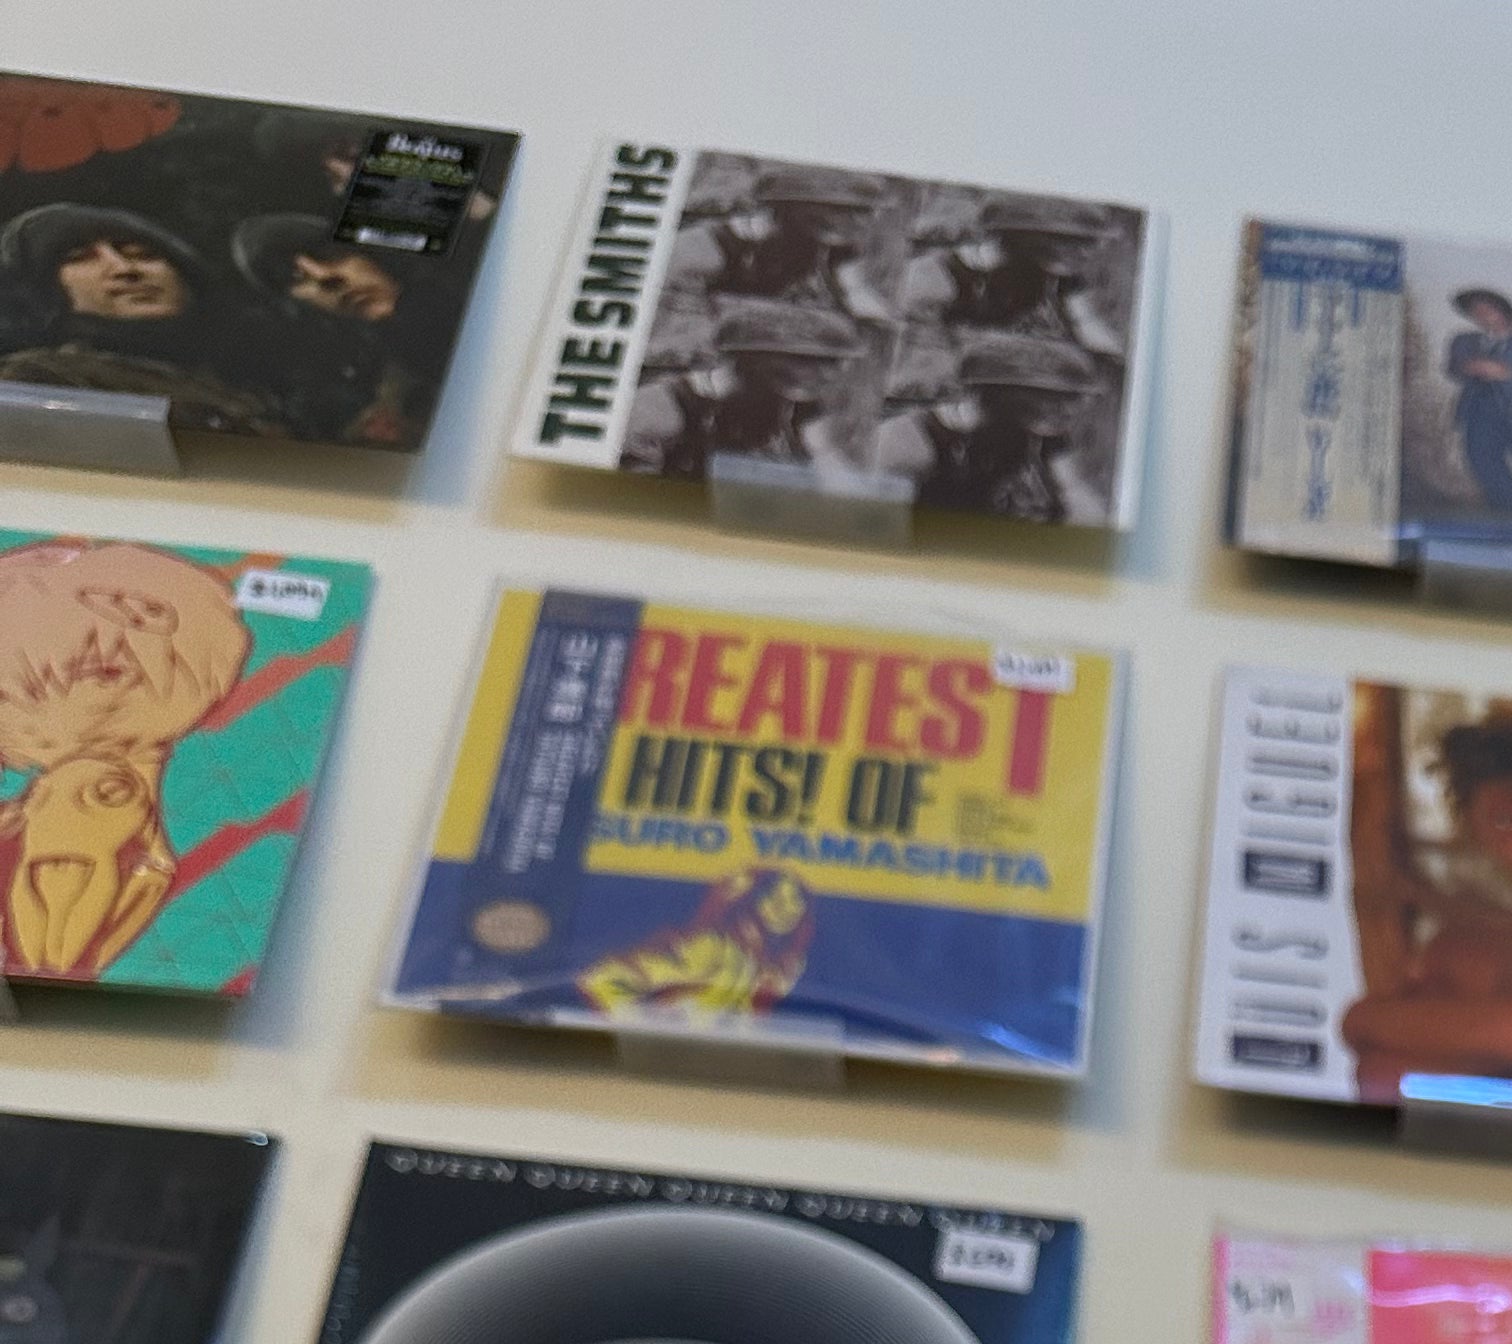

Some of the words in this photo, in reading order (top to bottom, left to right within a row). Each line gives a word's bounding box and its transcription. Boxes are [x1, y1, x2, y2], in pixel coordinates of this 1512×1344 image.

[571, 140, 681, 330] SMITHS
[538, 336, 625, 446] THE
[622, 733, 826, 829] HITS!
[846, 754, 942, 838] OF
[752, 833, 1052, 893] YAMASHITA
